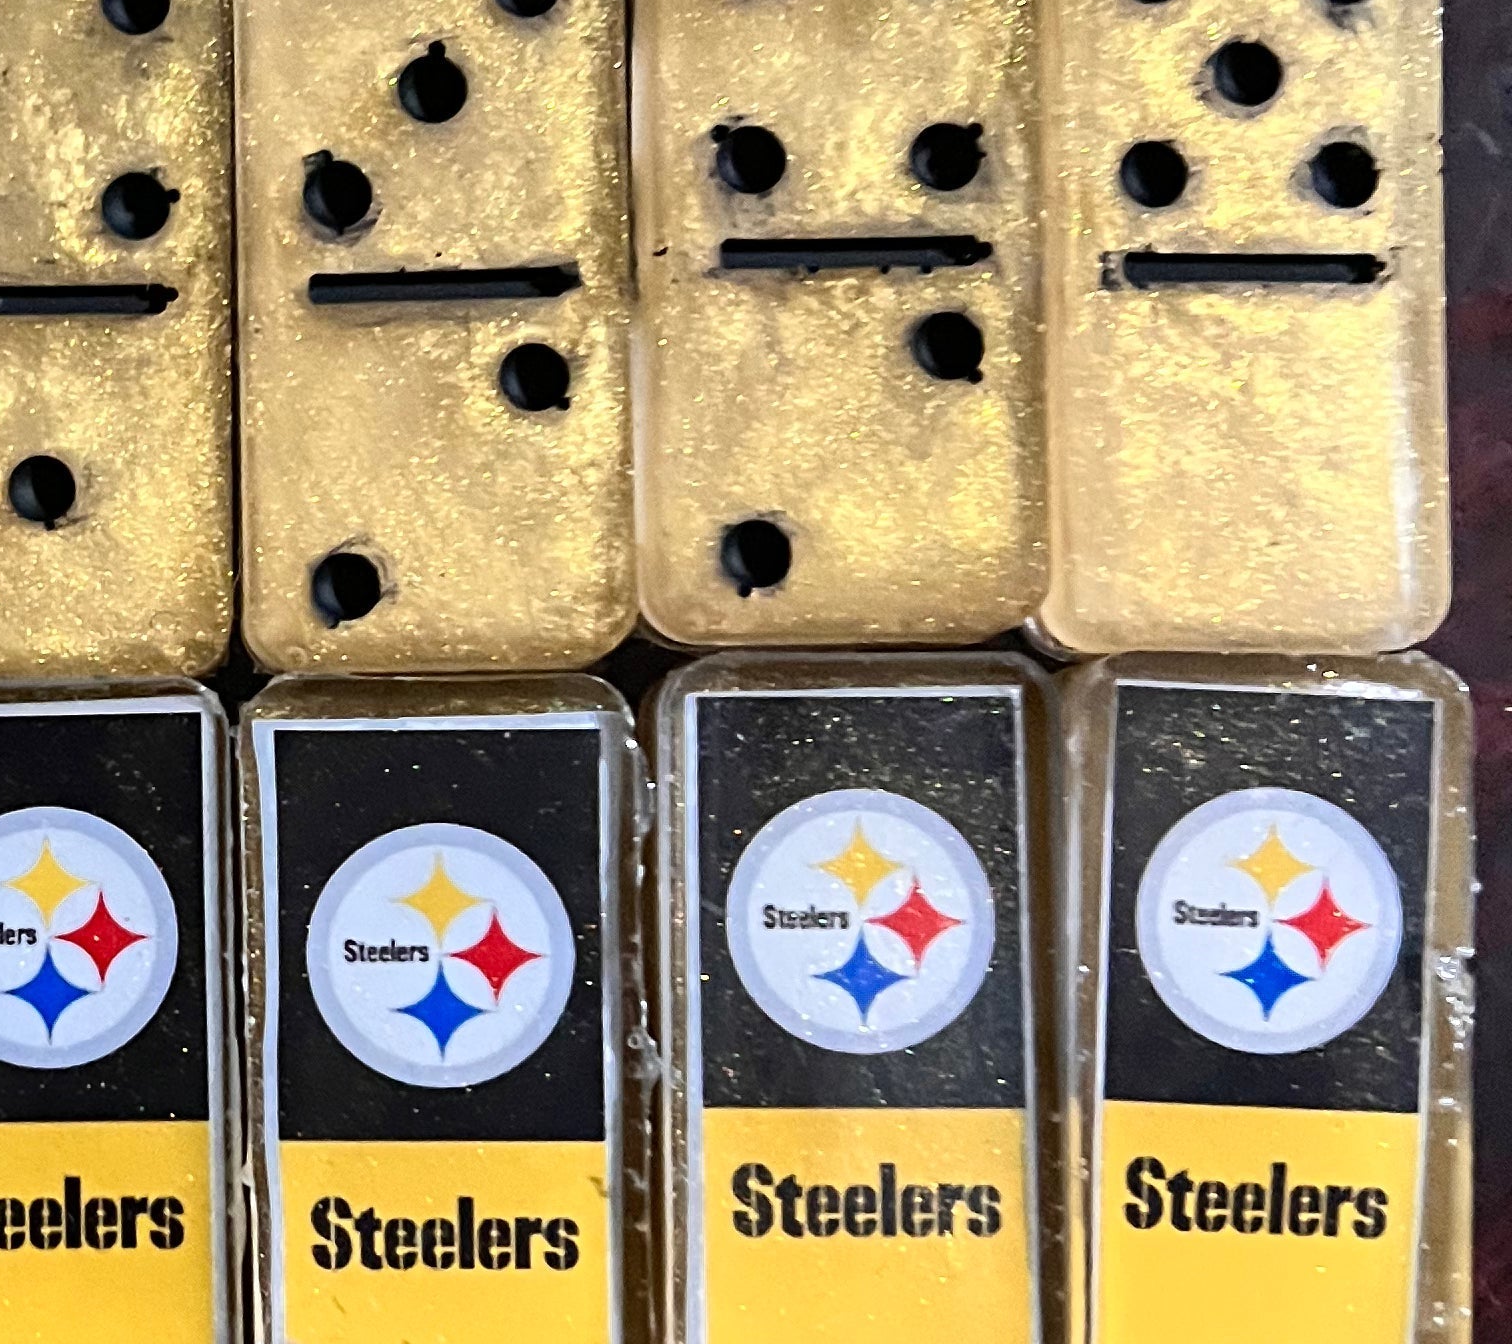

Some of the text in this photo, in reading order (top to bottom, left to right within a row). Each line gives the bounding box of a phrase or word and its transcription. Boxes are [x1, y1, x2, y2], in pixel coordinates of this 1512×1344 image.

[343, 938, 429, 963] Steelers
[311, 1197, 578, 1270] Steelers
[733, 1163, 1000, 1237] Steelers
[1126, 1157, 1387, 1237] Steelers
